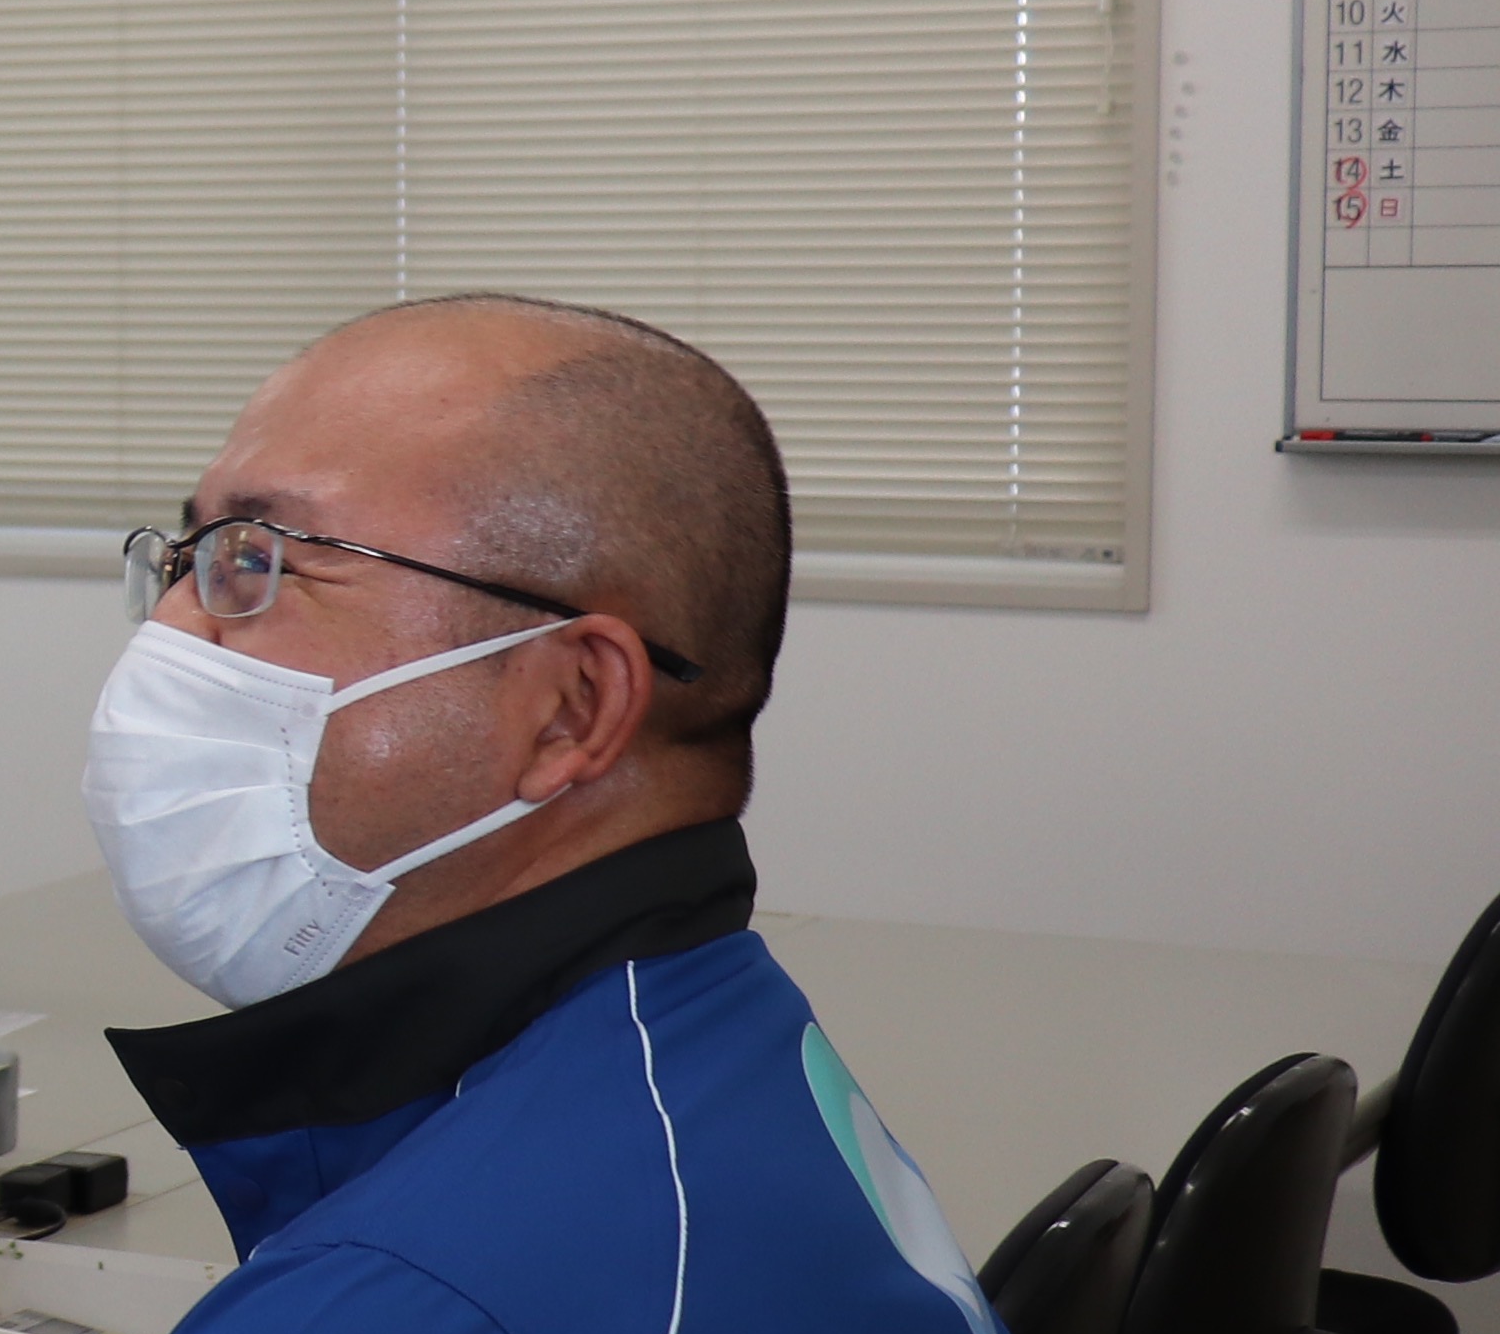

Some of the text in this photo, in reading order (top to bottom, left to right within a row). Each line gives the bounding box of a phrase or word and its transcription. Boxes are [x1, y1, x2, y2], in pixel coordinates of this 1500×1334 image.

[1337, 0, 1404, 25] 10 火
[1336, 41, 1406, 65] 11 水
[1336, 79, 1404, 104] 12 木
[1335, 118, 1402, 143] 13 金
[1335, 158, 1403, 181] 14 土
[1334, 197, 1398, 221] 15 日
